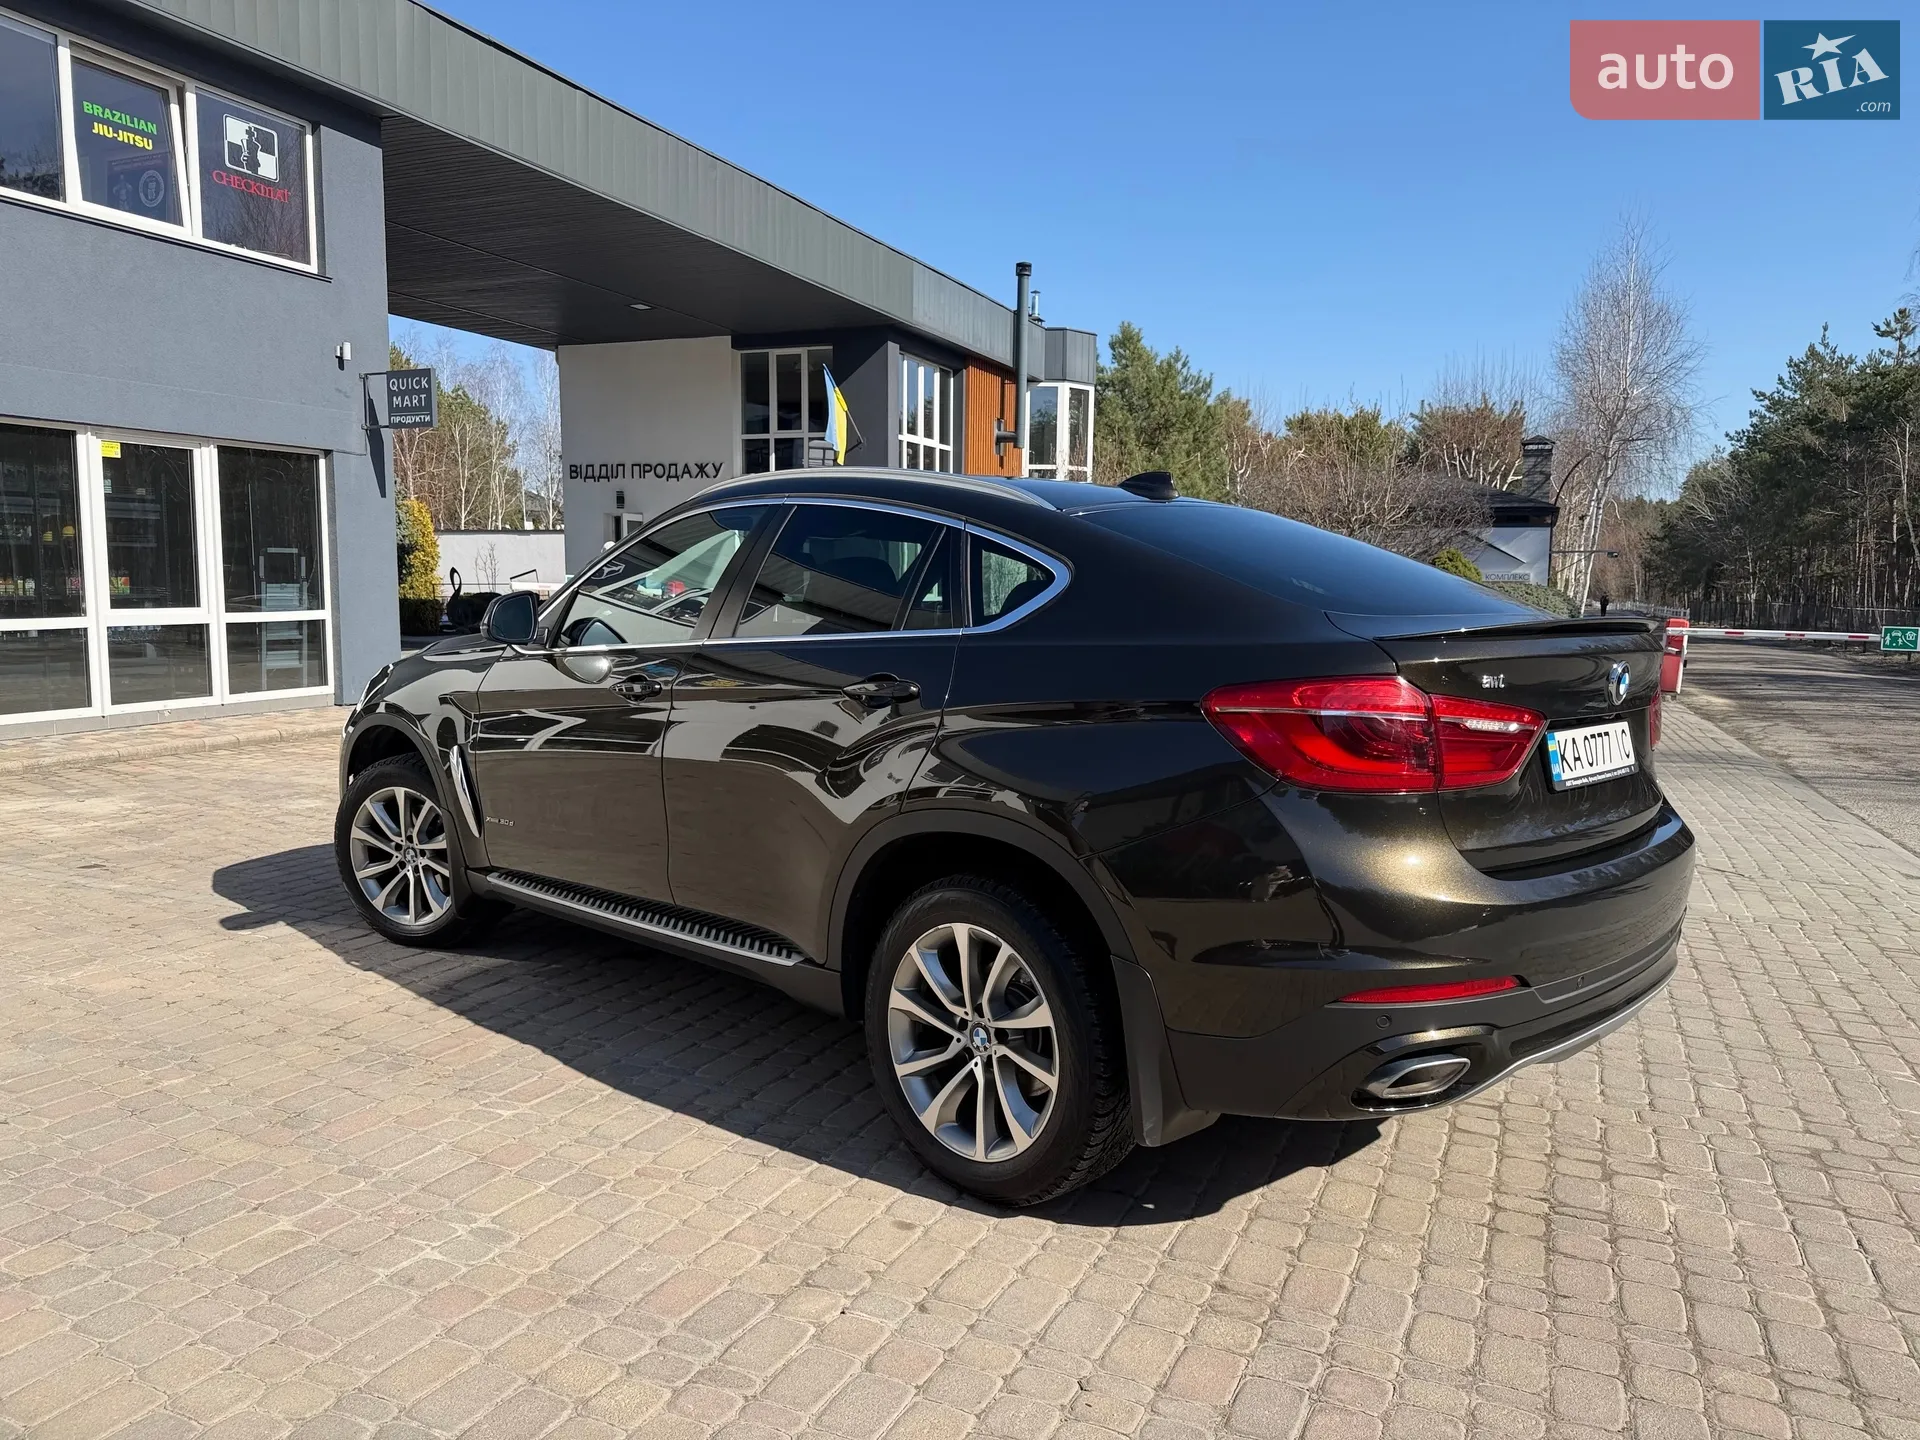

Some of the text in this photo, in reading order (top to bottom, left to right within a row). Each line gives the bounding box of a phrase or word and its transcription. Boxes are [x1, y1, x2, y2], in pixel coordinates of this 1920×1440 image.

[82, 100, 157, 135] BRAZILIAN
[92, 121, 153, 151] JIU-JITSU
[212, 169, 291, 203] CHECKMAT
[390, 376, 429, 392] QUICK
[393, 394, 427, 408] MART
[390, 415, 431, 424] ПРОДУКТИ
[569, 462, 724, 482] ВІДДІЛ ПРОДАЖУ
[1485, 573, 1530, 581] КОМПЛЕКС
[1557, 728, 1631, 774] KA 0777 IC
